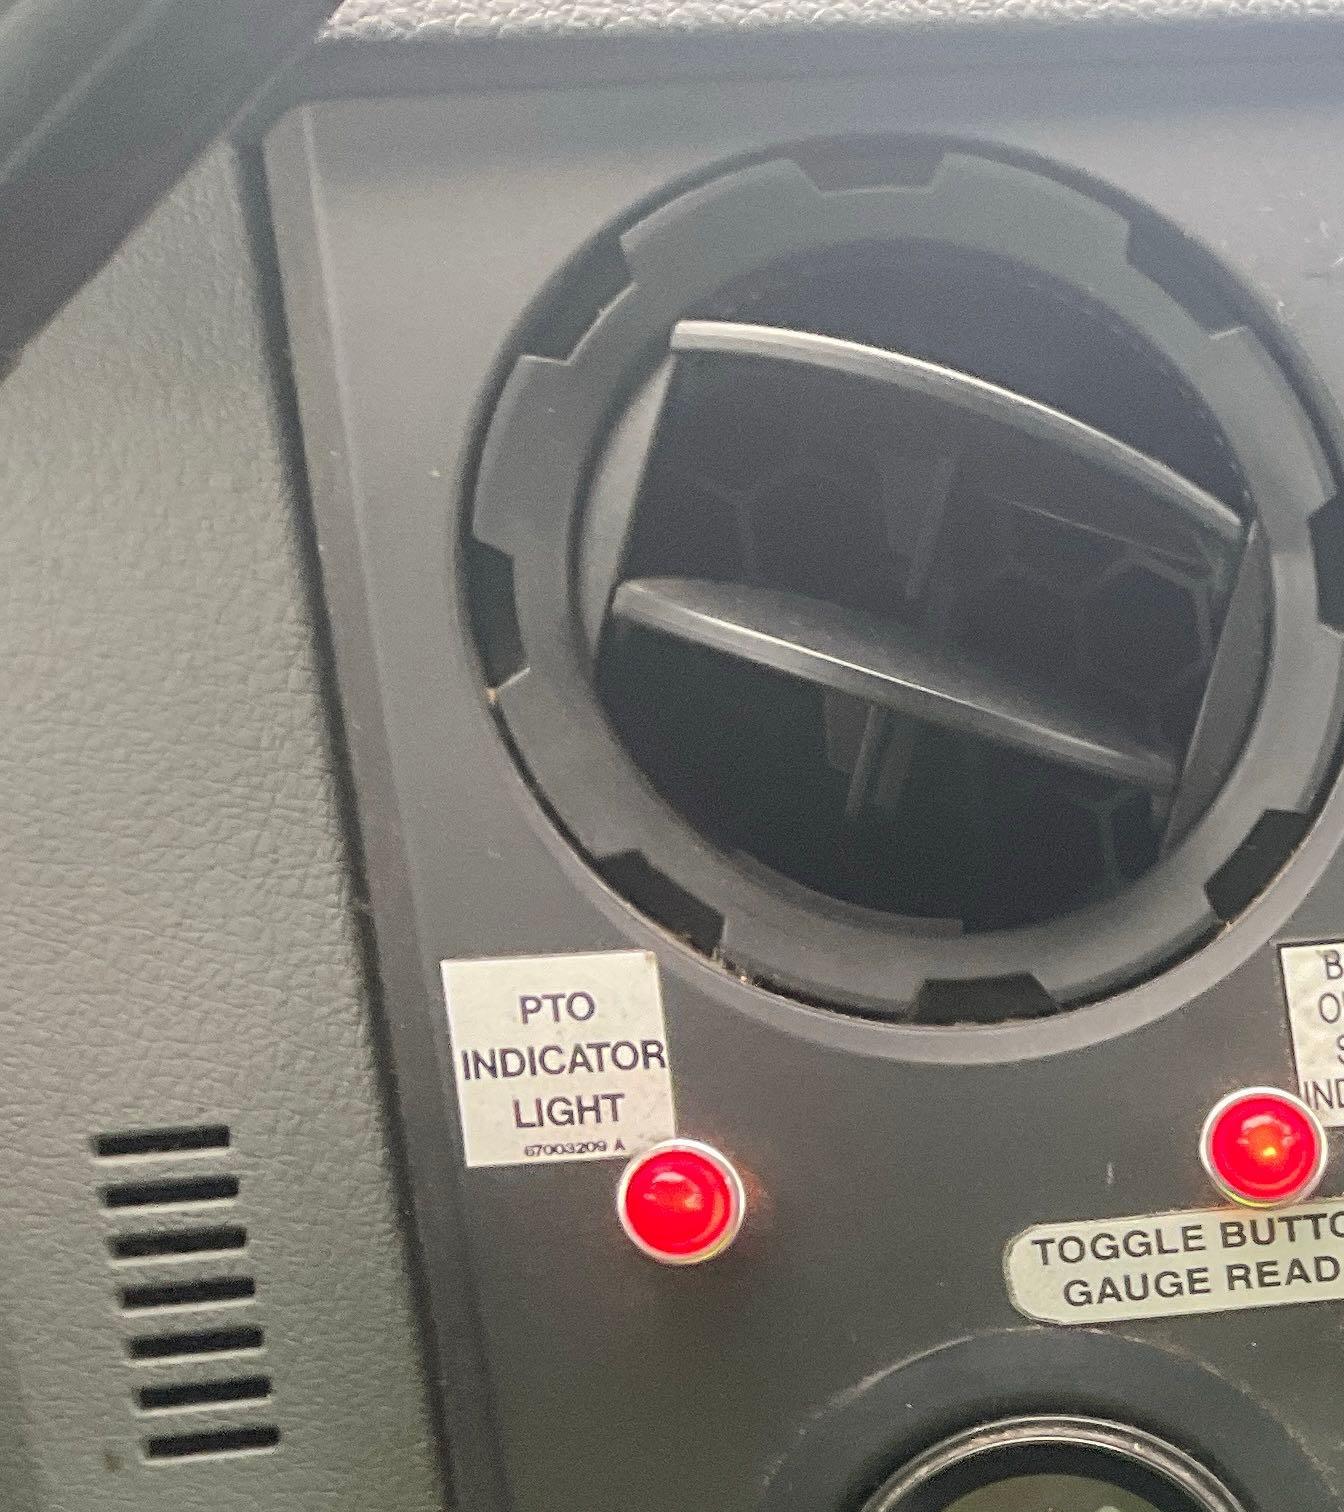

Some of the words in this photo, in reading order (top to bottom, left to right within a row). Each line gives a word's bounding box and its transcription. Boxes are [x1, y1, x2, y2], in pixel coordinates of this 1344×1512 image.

[518, 990, 597, 1025] PTO
[461, 1039, 667, 1081] INDICATOR
[512, 1092, 626, 1129] LIGHT
[613, 1138, 627, 1152] A
[1031, 1223, 1208, 1267] TOGGLE
[1062, 1265, 1213, 1308] GAUGE
[1225, 1254, 1342, 1292] READ
